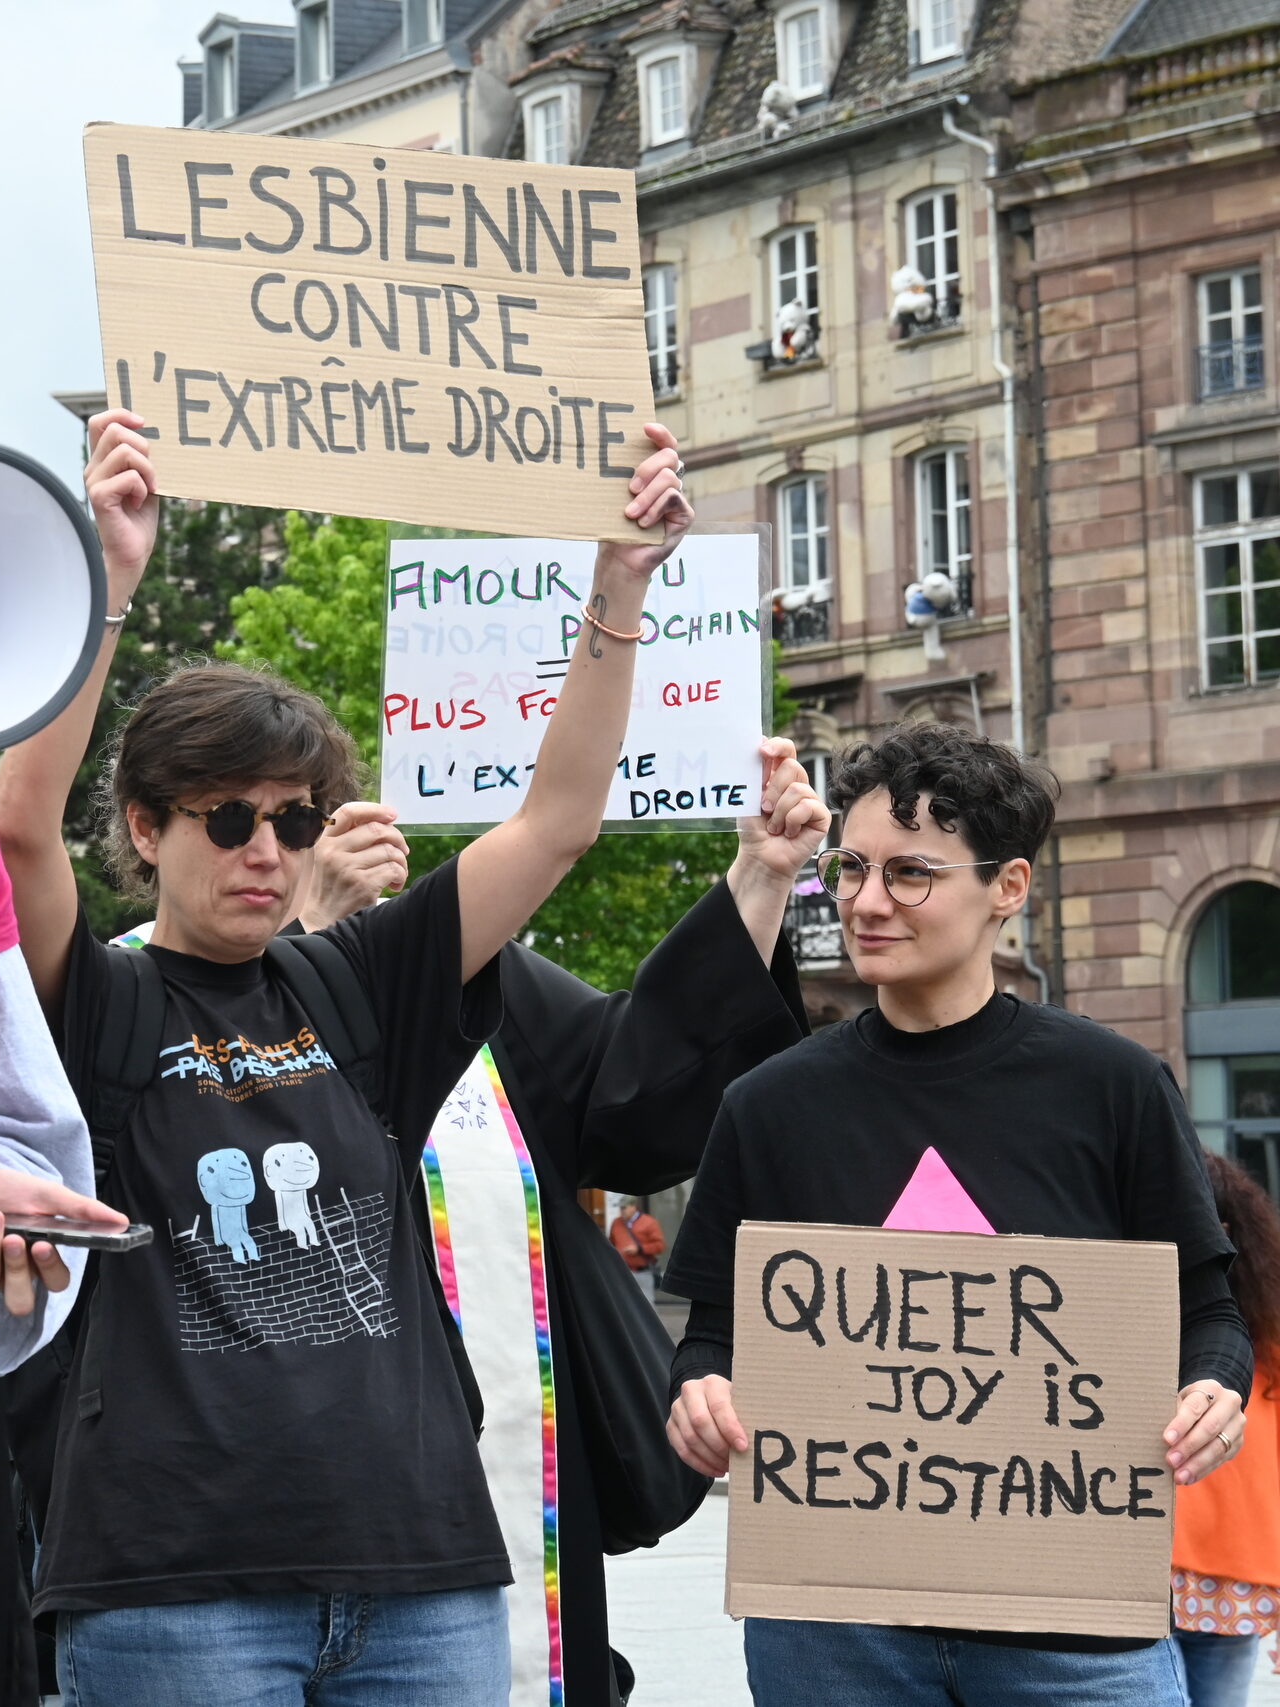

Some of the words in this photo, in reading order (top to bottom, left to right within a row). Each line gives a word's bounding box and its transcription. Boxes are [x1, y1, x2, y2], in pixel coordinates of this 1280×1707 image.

[116, 154, 631, 280] LESBIENNE
[251, 272, 543, 376] CONTRE
[116, 350, 430, 455] L'EXTRÊME
[445, 385, 635, 478] DROITE
[391, 561, 581, 611] AMOUR
[649, 558, 685, 587] U
[561, 608, 760, 656] POCHAIN
[384, 694, 487, 736] PLUS
[517, 689, 559, 721] FO
[662, 680, 721, 706] QUE
[630, 785, 747, 818] DROITE
[177, 1054, 224, 1083] PAS
[238, 1027, 315, 1062] PONTS
[761, 1249, 1079, 1366] QUEER
[865, 1363, 1006, 1425] JOY
